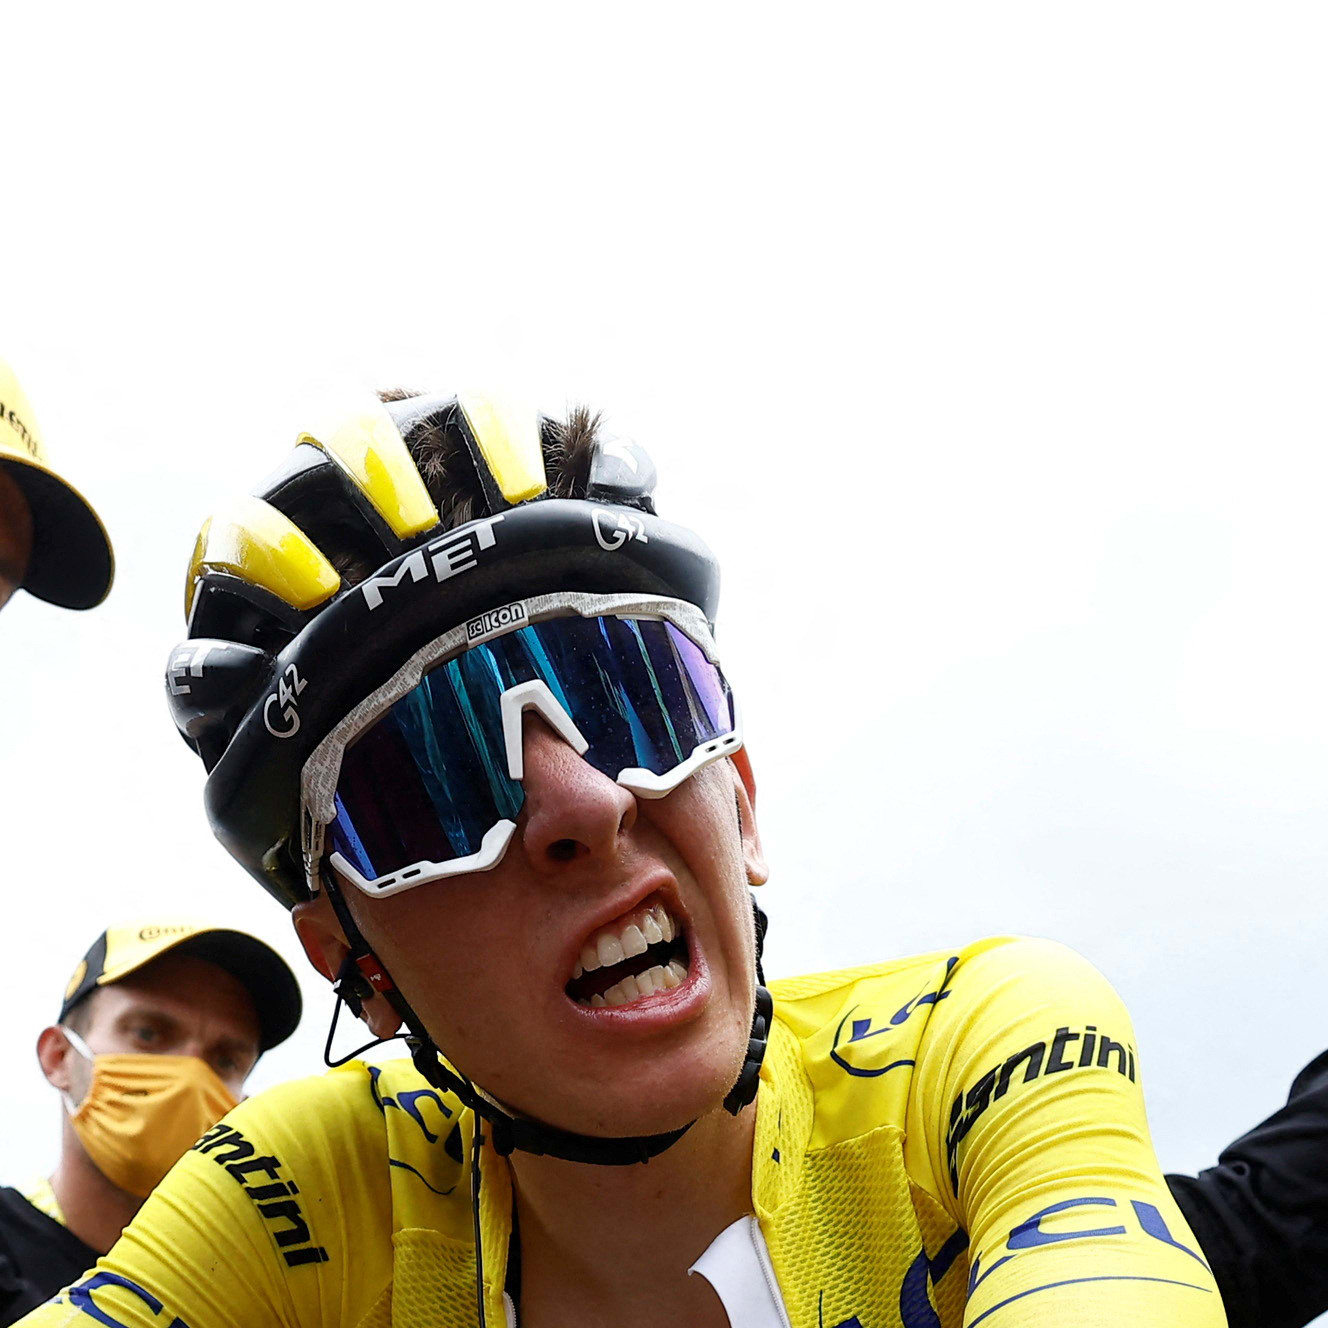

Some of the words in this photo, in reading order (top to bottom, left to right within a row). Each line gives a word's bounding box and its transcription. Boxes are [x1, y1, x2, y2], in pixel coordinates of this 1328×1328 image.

[362, 515, 505, 612] MET
[263, 663, 309, 739] G42
[192, 1123, 329, 1267] antini
